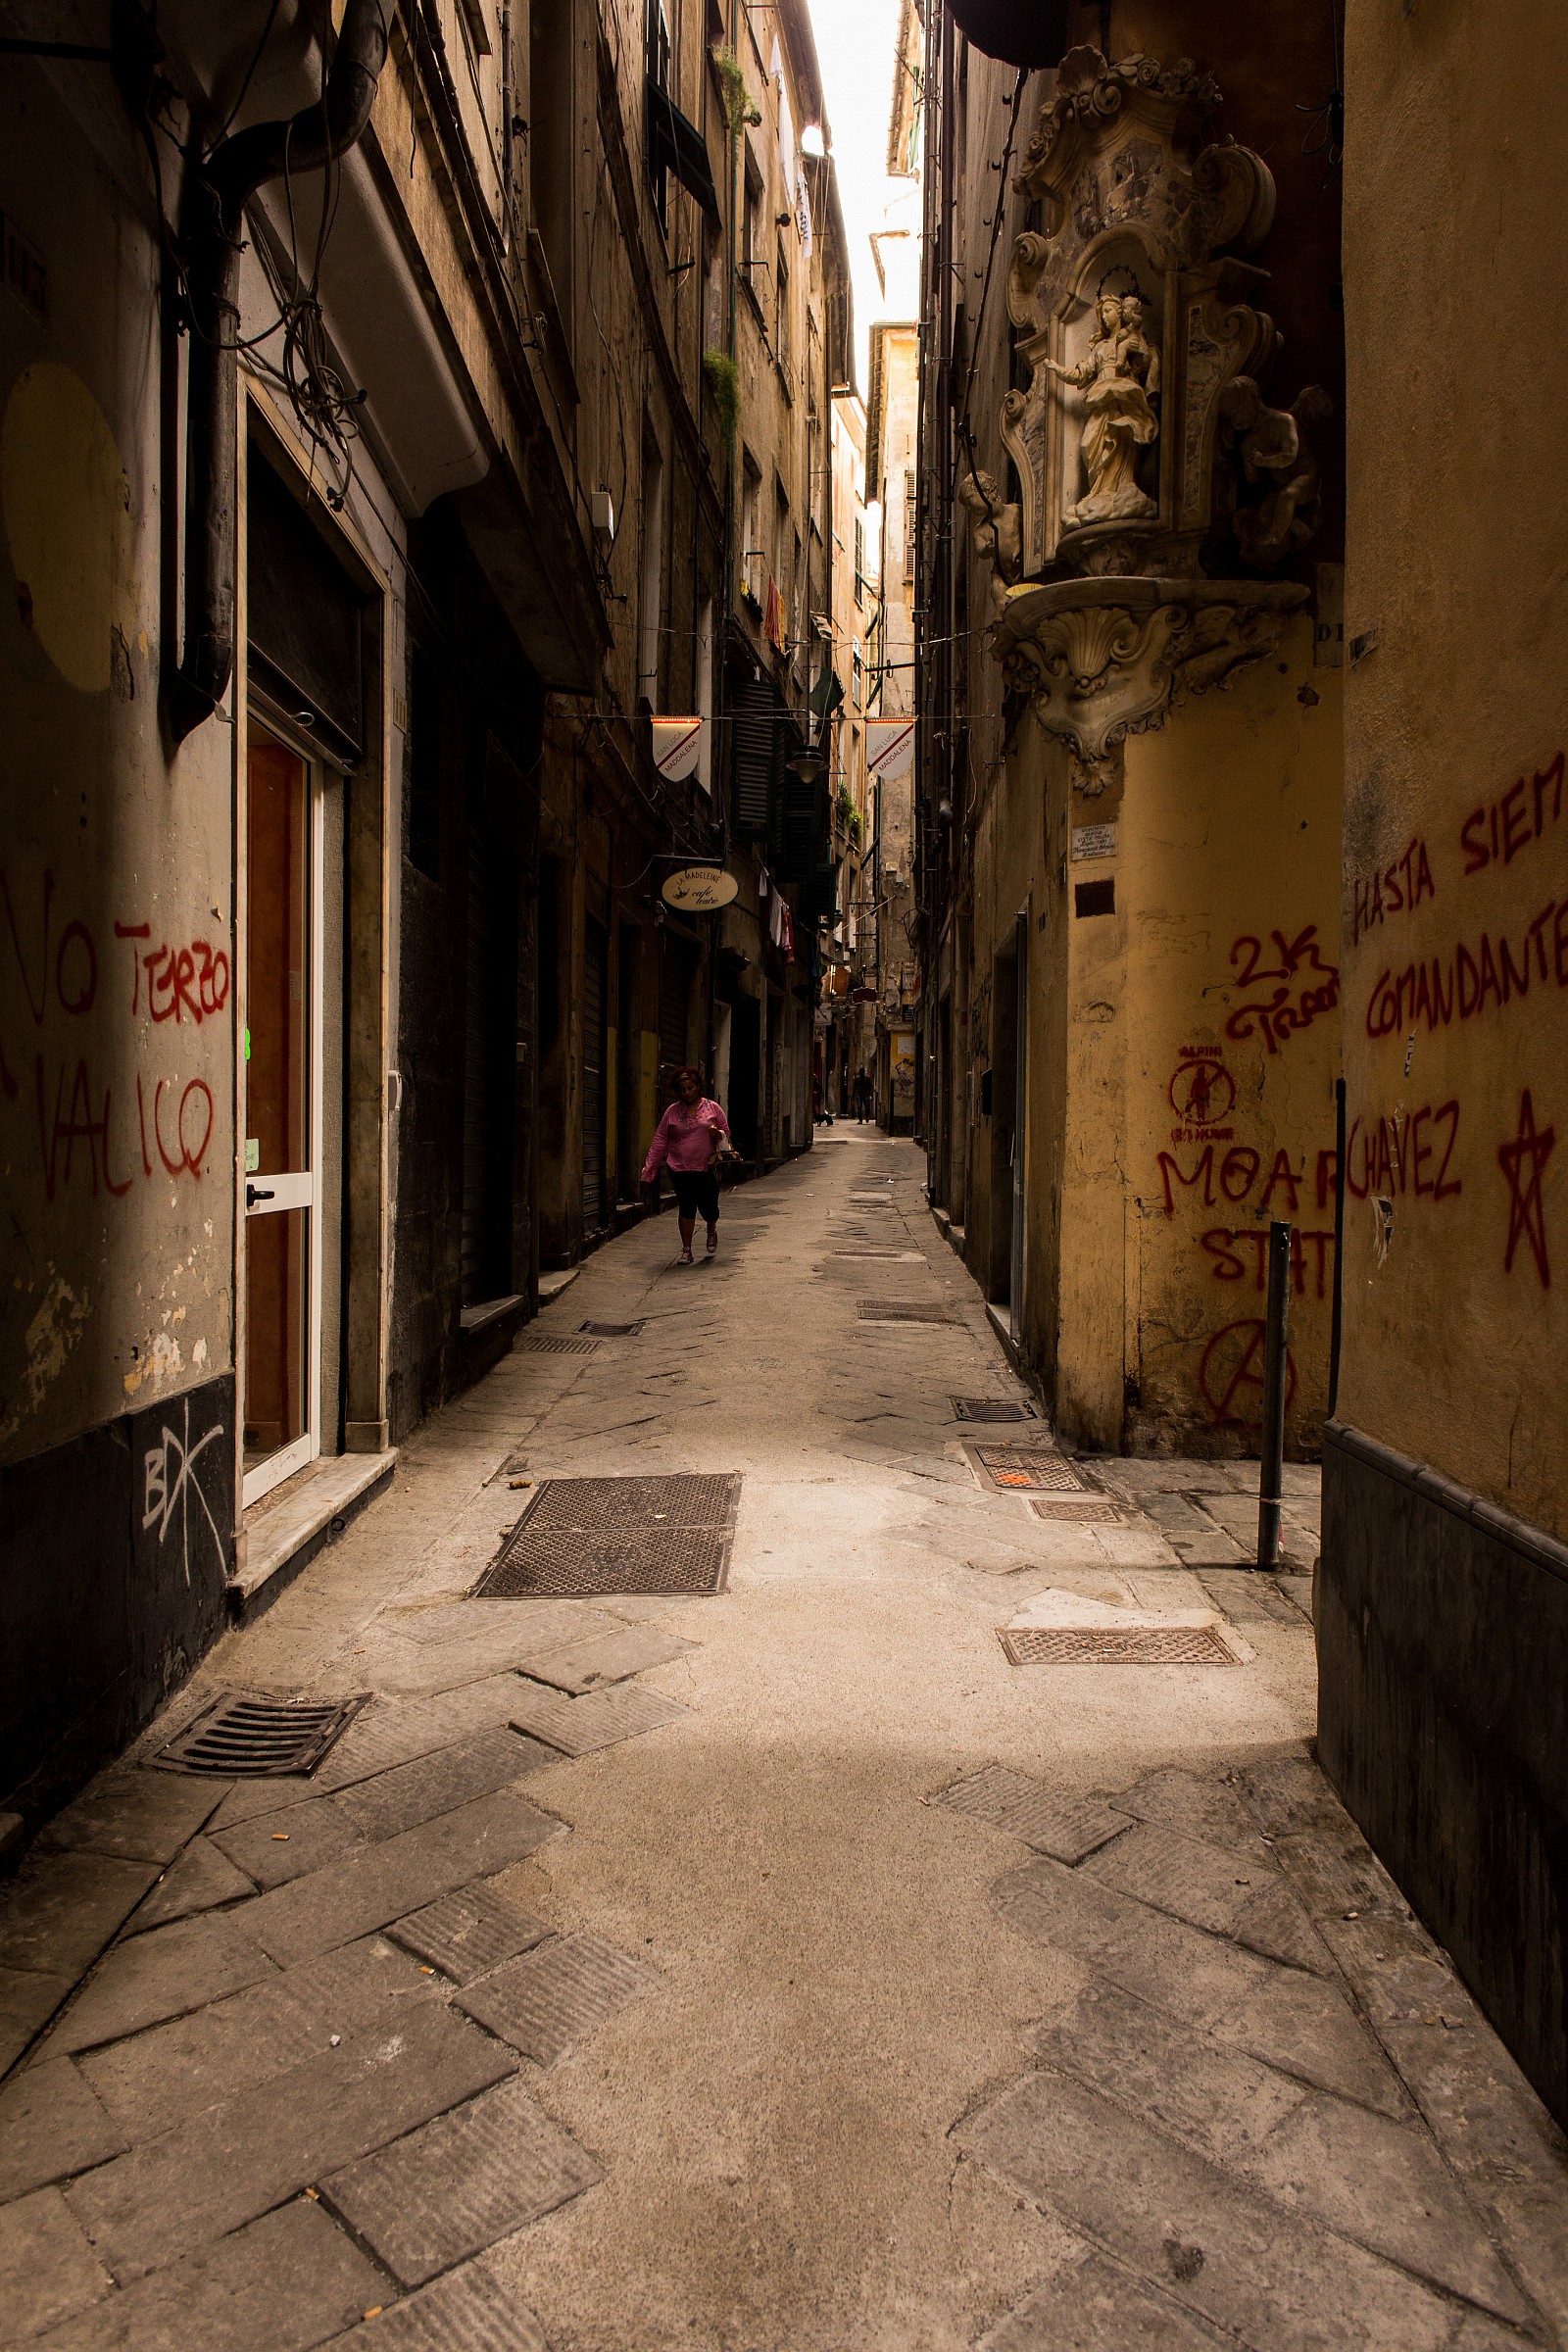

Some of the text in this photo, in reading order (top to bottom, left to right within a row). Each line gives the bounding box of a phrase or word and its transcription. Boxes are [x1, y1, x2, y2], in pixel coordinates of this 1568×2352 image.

[658, 731, 684, 758] SAN LUCA
[664, 740, 698, 772] MADDALENA
[870, 730, 897, 757] SAN LUCA
[878, 740, 912, 771] MADDALENA
[676, 871, 720, 886] LA MADELEINE
[1354, 838, 1435, 947] HASTA
[115, 921, 229, 1024] TERZO
[1367, 899, 1568, 1038] COMANDANTE
[1179, 1046, 1223, 1057] ALPINI
[36, 1054, 213, 1203] VALICO
[1196, 1127, 1234, 1141] HOME
[1346, 1101, 1462, 1200] CHAVEZ
